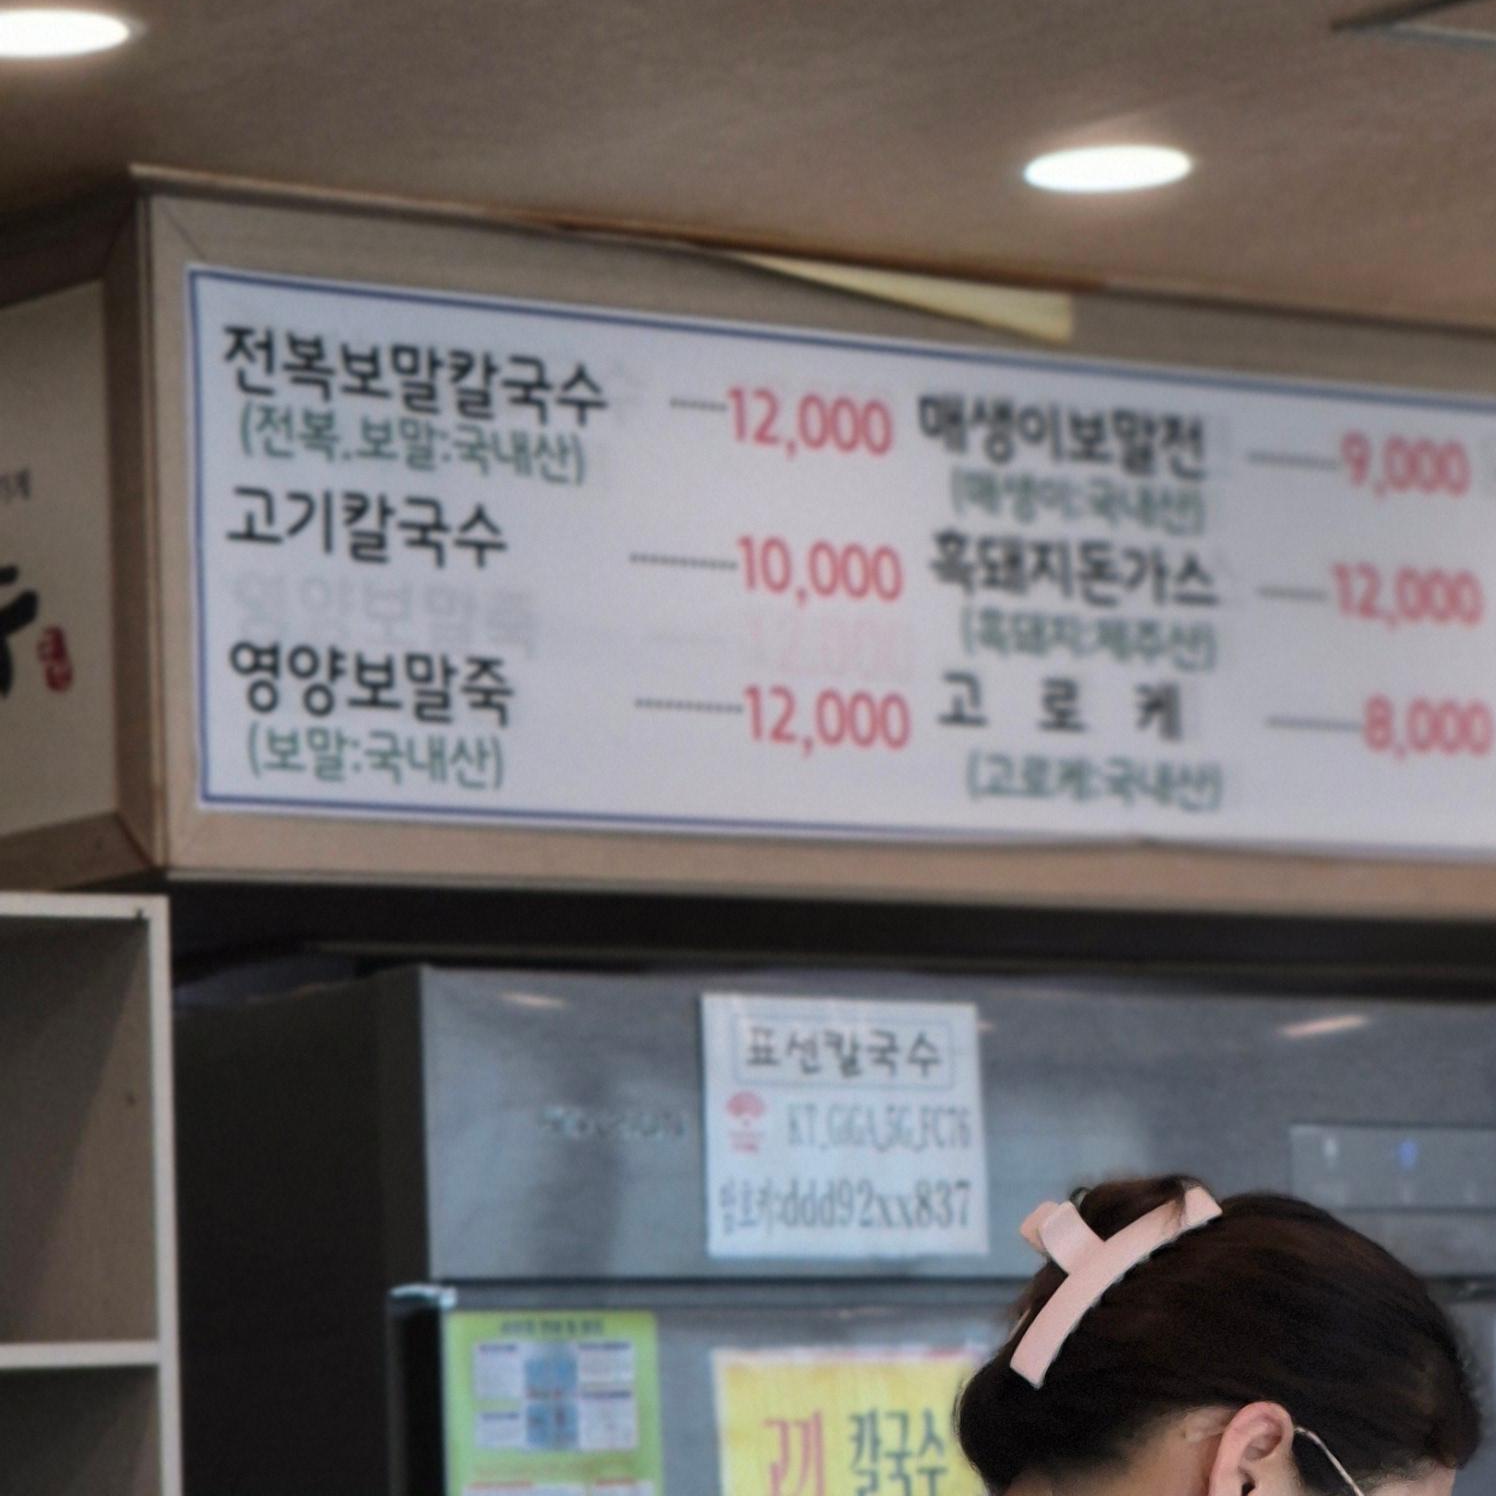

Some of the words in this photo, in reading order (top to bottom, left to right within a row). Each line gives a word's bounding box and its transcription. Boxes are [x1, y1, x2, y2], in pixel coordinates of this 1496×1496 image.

[224, 324, 609, 426] 전복보말칼국수
[728, 385, 894, 459] 12,000
[918, 395, 1207, 482] 매생이보말전
[1342, 429, 1471, 498] 9,000
[226, 485, 508, 570] 고기칼국수
[738, 534, 903, 606] 10,000
[930, 528, 1219, 606] 흑돼지돈가스
[1332, 562, 1485, 629] 12,000
[229, 639, 515, 726] 영양보말죽
[743, 684, 910, 757] 12,000
[1362, 694, 1495, 761] 8,000
[247, 721, 504, 791] (보말:국내산)
[746, 1026, 943, 1079] 표선칼국수
